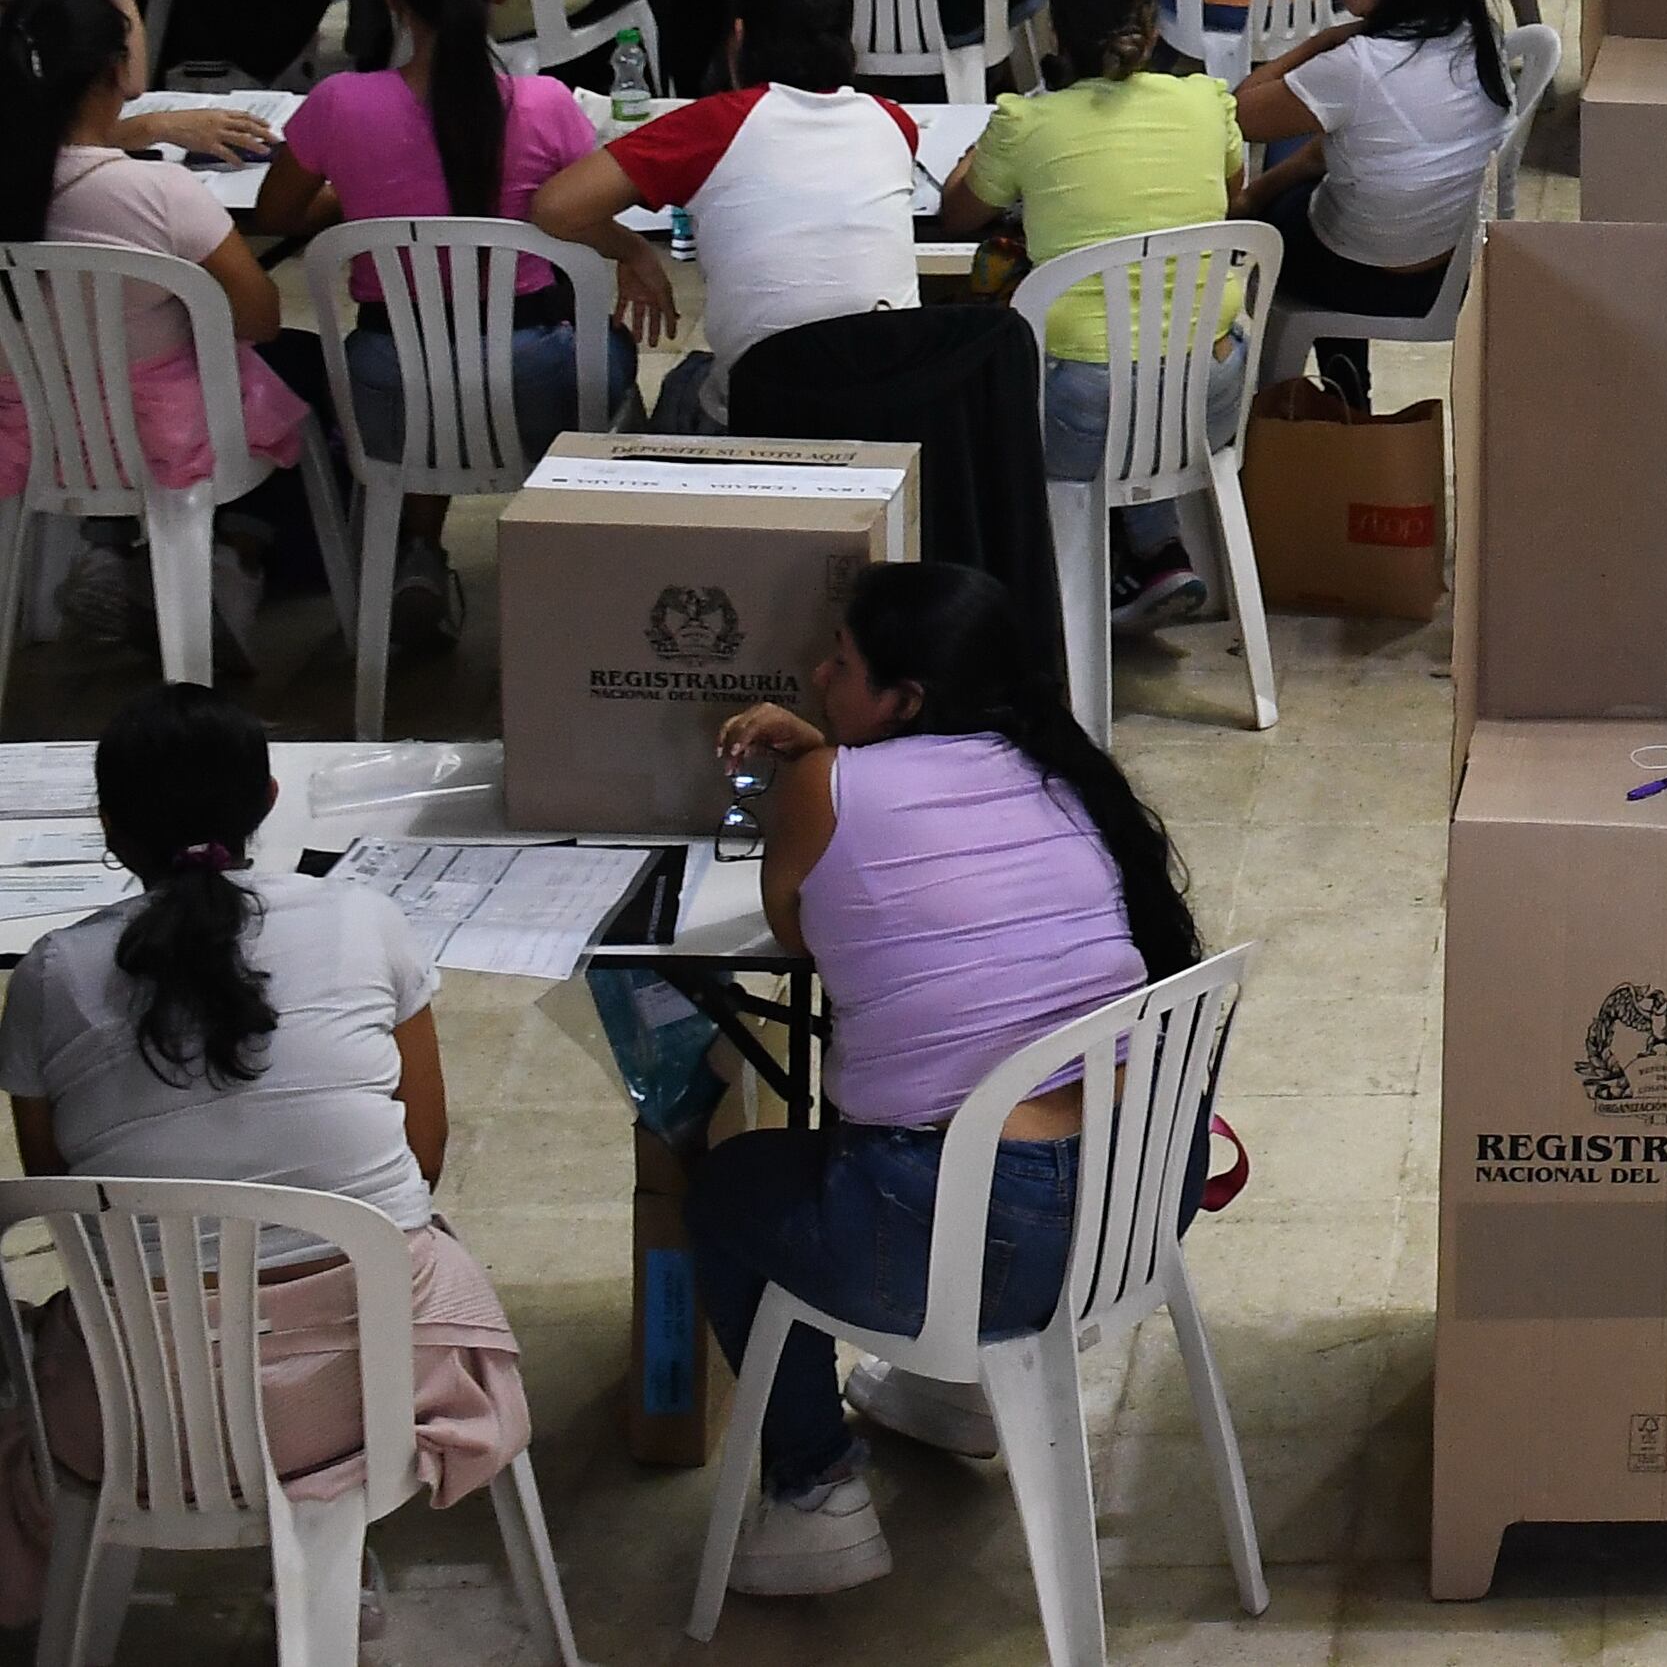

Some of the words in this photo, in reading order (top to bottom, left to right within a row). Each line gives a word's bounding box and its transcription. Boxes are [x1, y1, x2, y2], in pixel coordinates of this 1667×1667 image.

[611, 445, 708, 455] DEPOSITE
[715, 447, 741, 457] SU
[747, 449, 802, 459] VOTO
[590, 669, 799, 692] REGISTRADURÍA
[590, 689, 661, 701] NACIONAL
[668, 690, 696, 702] DEL
[702, 691, 751, 702] ESTADO
[1475, 1167, 1601, 1183] NACIONAL
[1610, 1168, 1660, 1184] DEL
